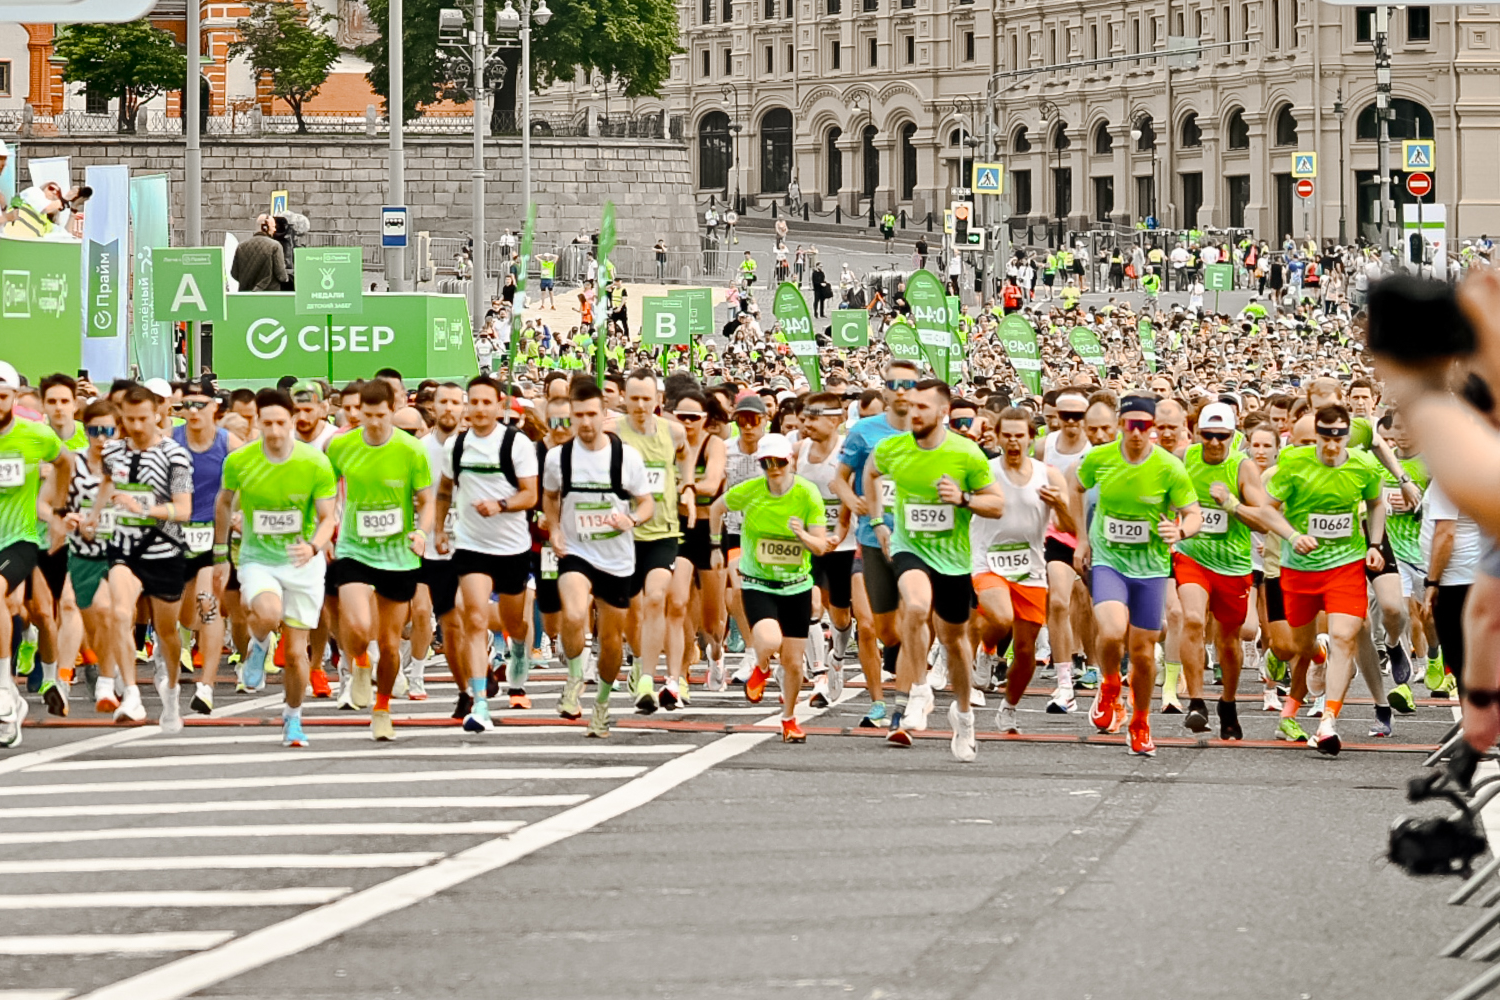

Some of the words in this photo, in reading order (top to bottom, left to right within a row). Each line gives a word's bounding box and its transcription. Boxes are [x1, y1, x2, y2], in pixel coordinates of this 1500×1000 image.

[96, 252, 113, 307] Прайм
[1212, 272, 1224, 288] E
[170, 273, 208, 312] A
[138, 277, 149, 339] зелёный
[655, 312, 677, 338] B
[841, 322, 860, 343] C
[297, 325, 395, 352] СБЕР
[260, 514, 295, 527] 7045
[363, 513, 396, 528] 8303
[911, 509, 947, 522] 8596
[1109, 522, 1142, 536] 8120
[1312, 517, 1350, 530] 10662
[761, 542, 801, 556] 10860
[991, 554, 1029, 567] 10156
